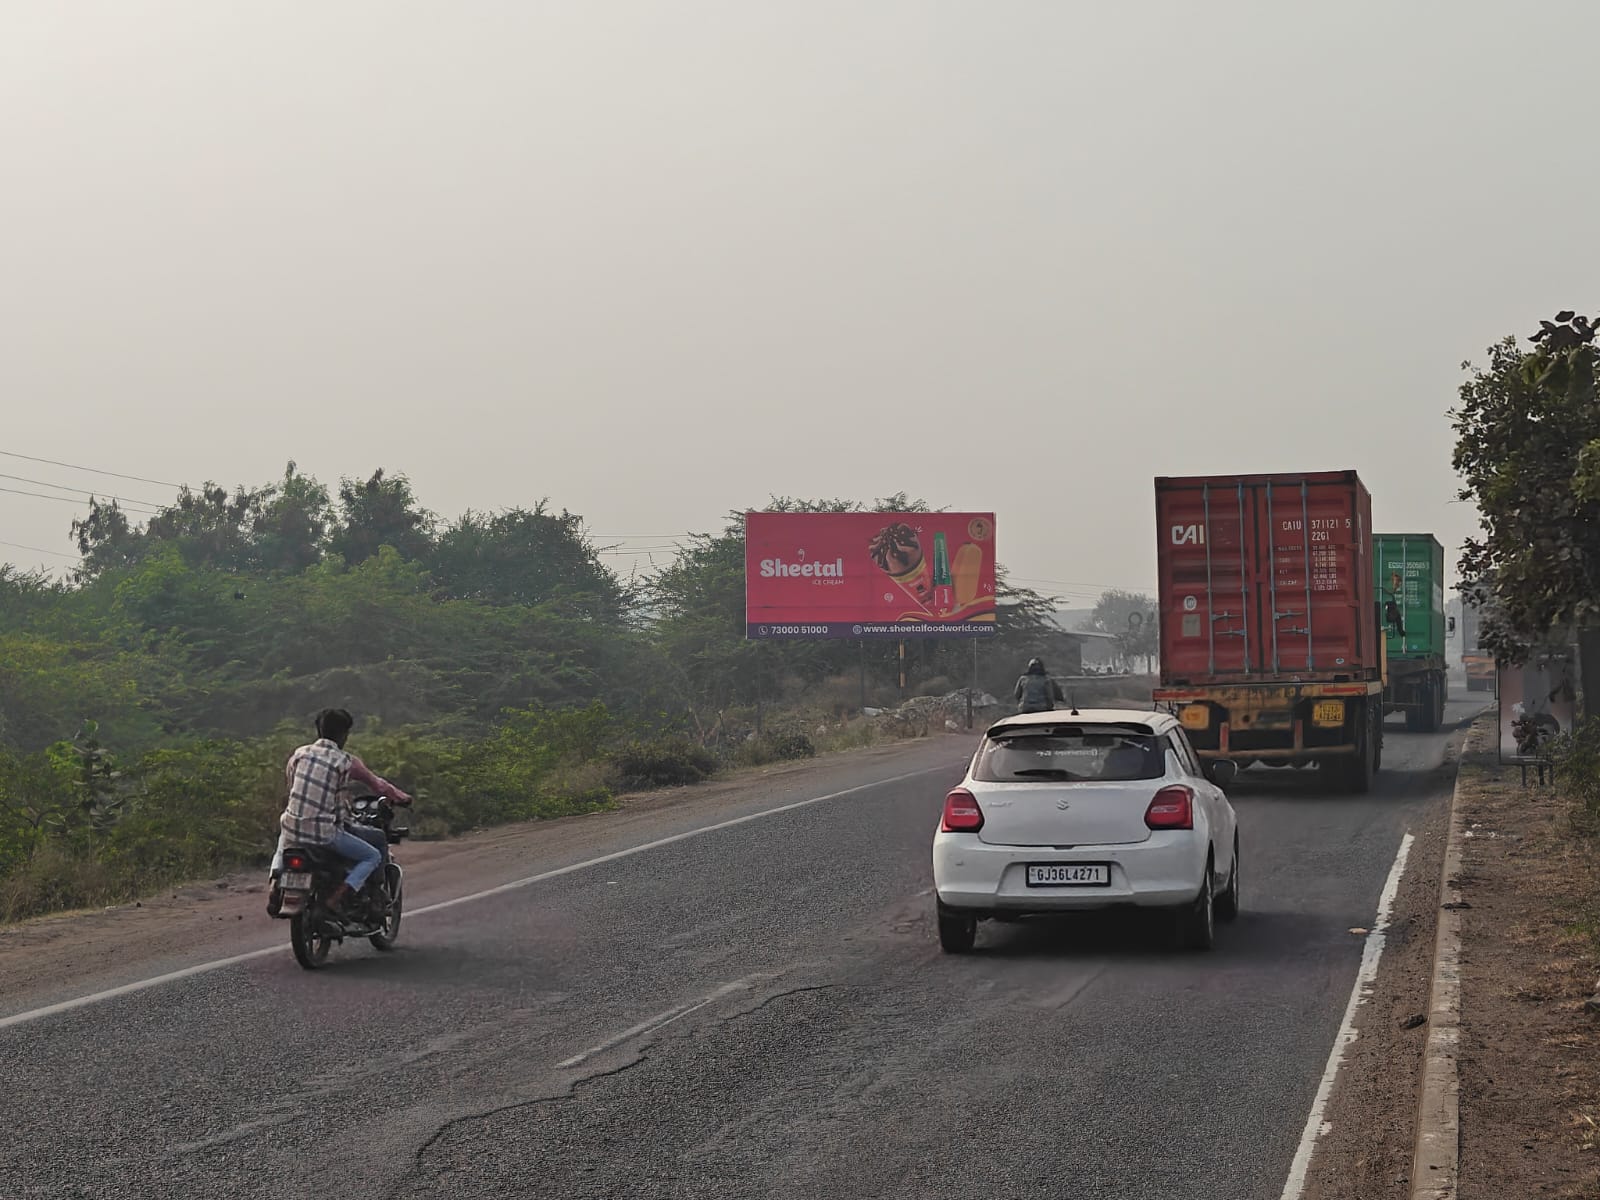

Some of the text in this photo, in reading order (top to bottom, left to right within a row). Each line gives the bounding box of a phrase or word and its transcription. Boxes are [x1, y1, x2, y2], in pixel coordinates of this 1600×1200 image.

[1282, 518, 1351, 531] CAIU 371121 5
[1171, 524, 1204, 545] CAI
[1311, 531, 1330, 541] 22G1
[760, 558, 843, 577] Sheetal
[771, 625, 828, 634] 73000 51000
[863, 623, 994, 634] www.sheetalfoodworld.com
[1037, 868, 1099, 881] GJ36L4271
